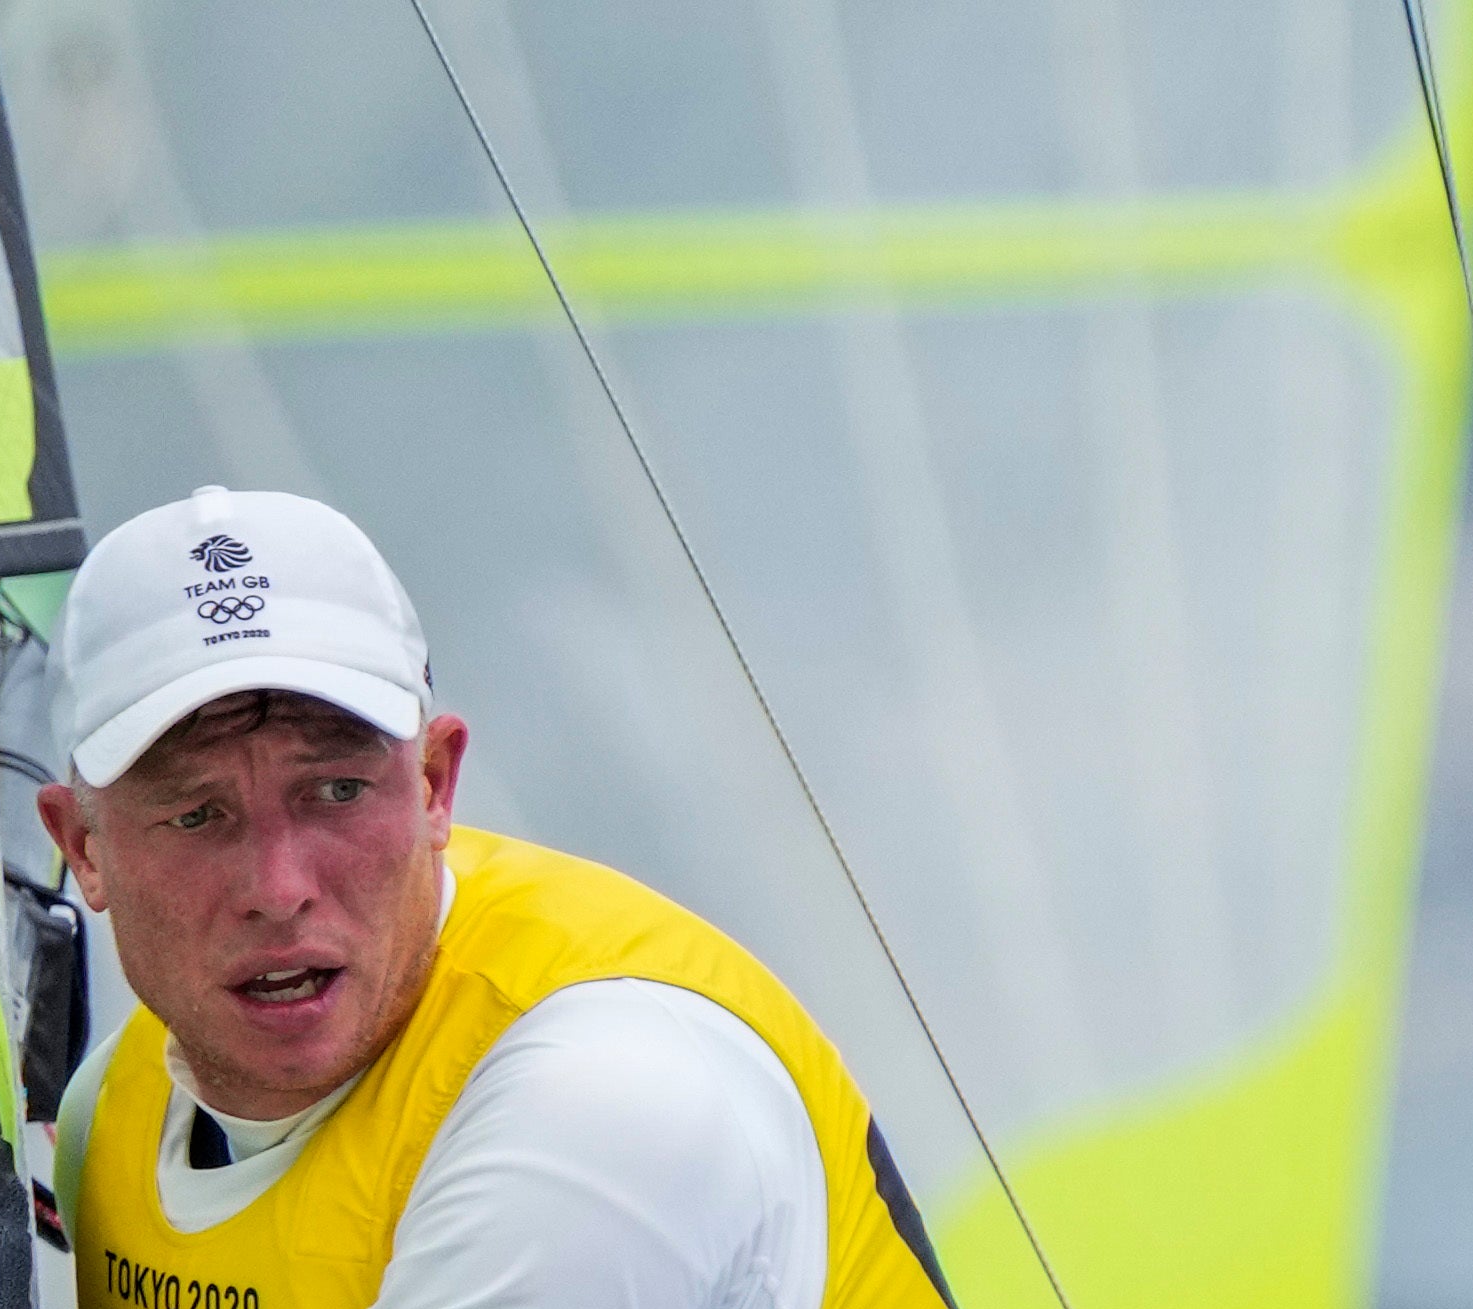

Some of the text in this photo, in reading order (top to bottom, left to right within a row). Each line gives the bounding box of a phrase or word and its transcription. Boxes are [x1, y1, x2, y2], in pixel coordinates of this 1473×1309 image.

[183, 575, 271, 599] TEAM GB
[203, 629, 271, 647] TOKYO 2020
